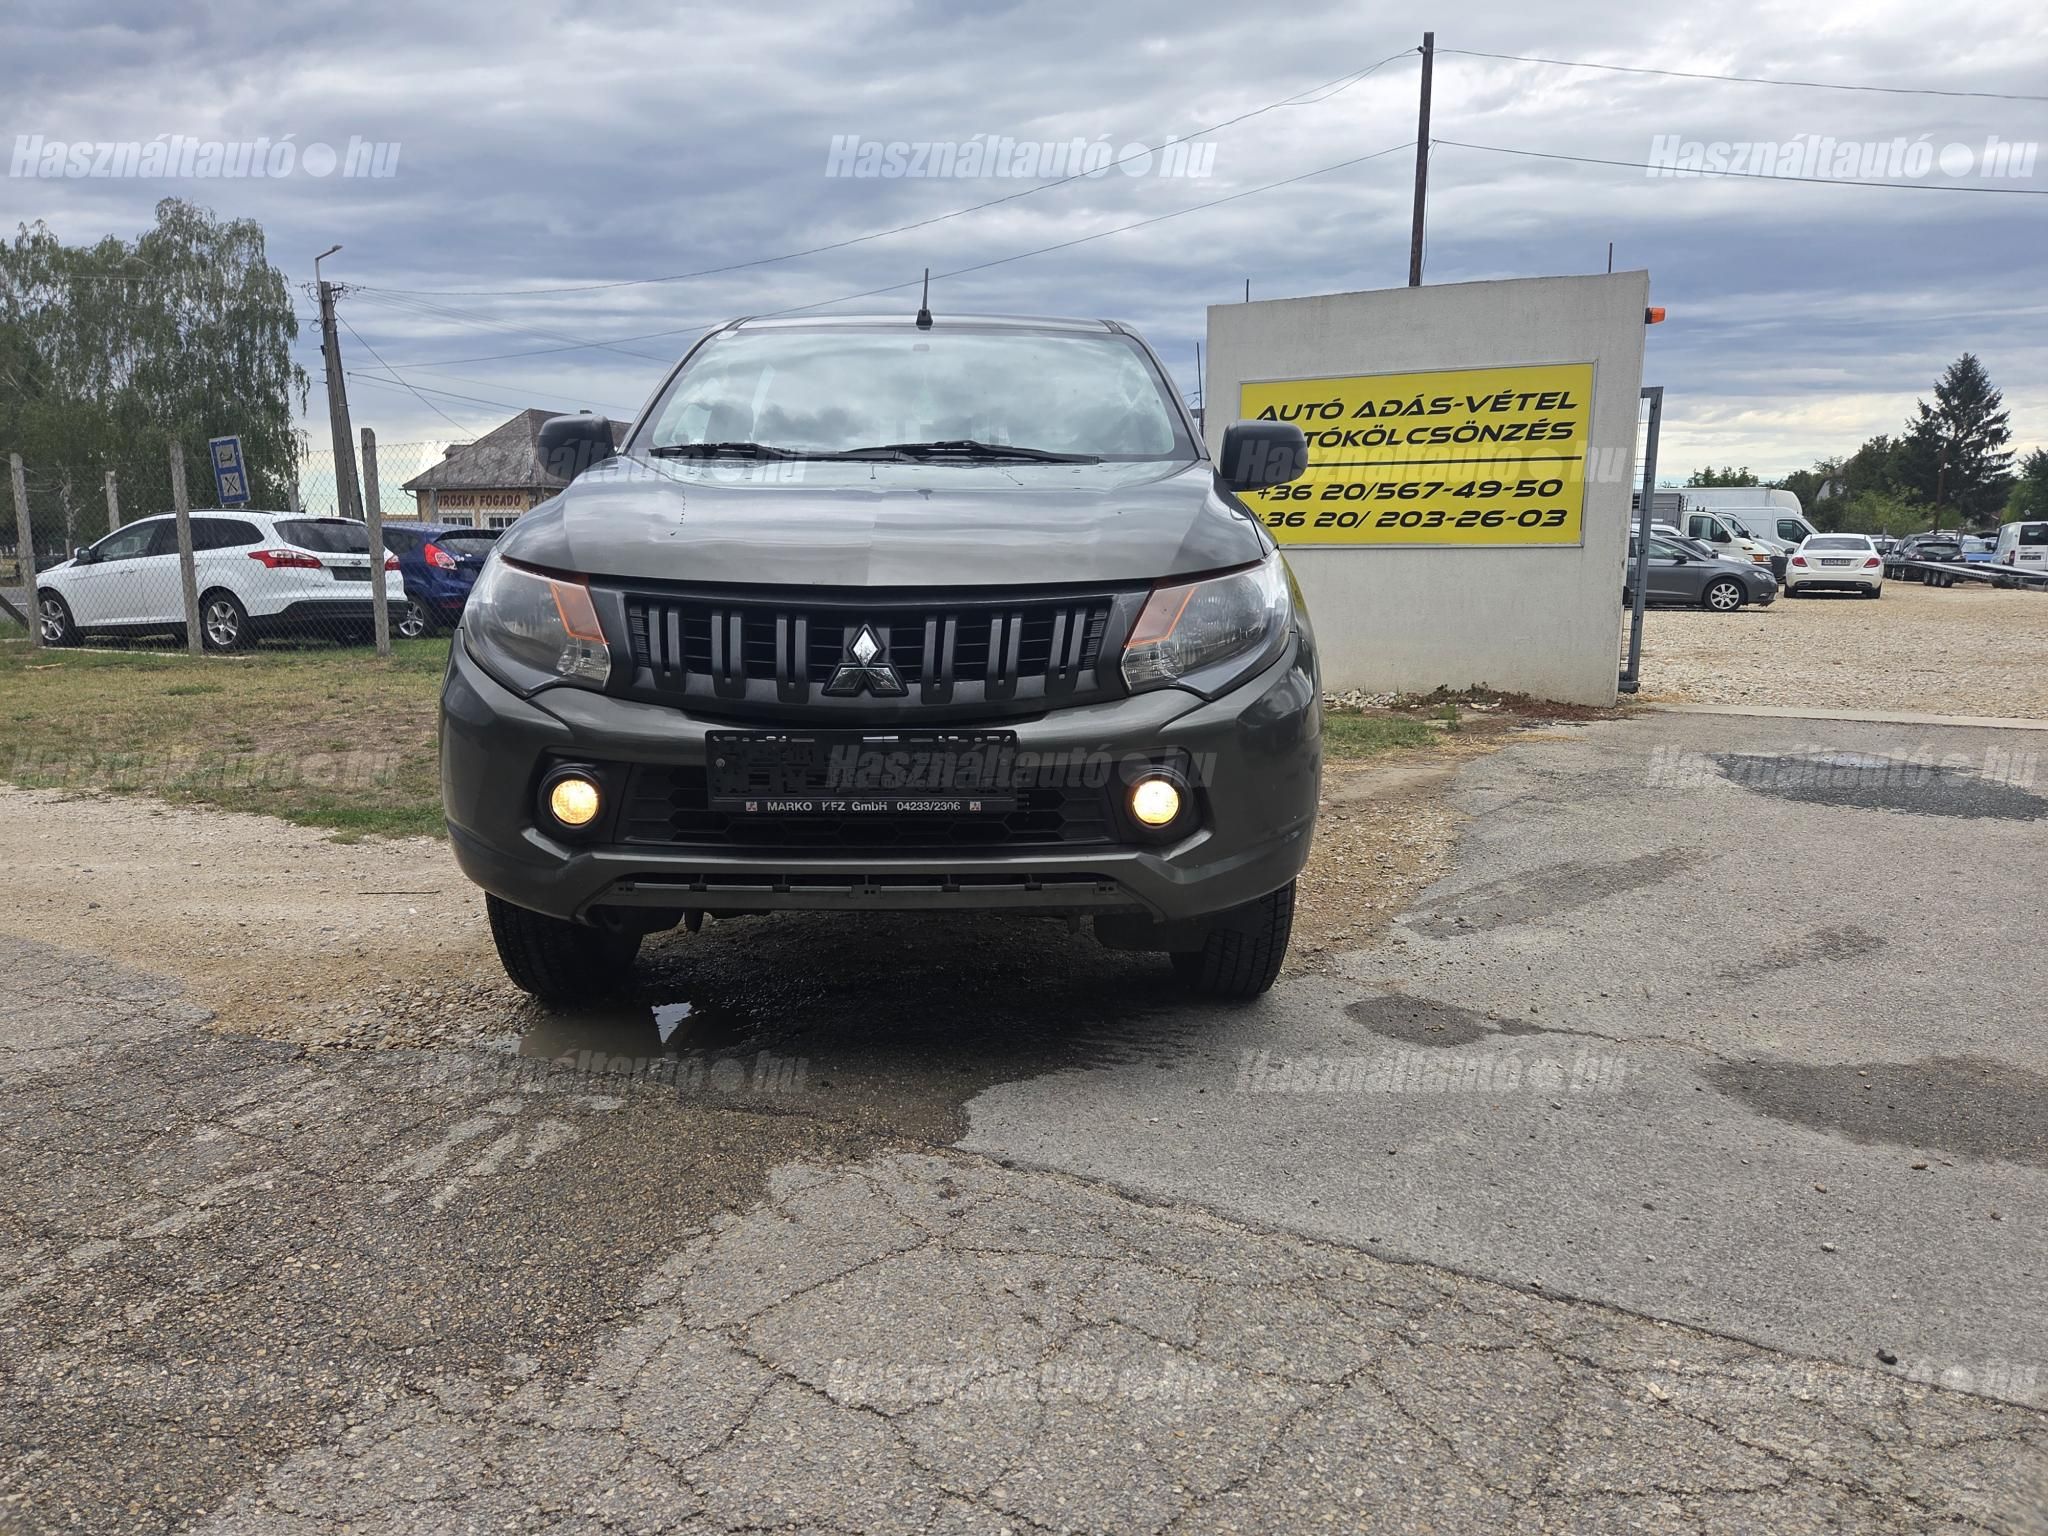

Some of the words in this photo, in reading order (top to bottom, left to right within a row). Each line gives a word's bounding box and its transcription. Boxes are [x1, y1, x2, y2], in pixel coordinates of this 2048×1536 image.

[1256, 398, 1345, 421] AUTÓ
[1351, 389, 1578, 418] ADÁS-VÉTEL
[1303, 418, 1577, 448] TÓKÖLCSÖNZÉS
[1257, 484, 1314, 501] +36
[1320, 479, 1564, 501] 20/567-49-50
[1375, 509, 1568, 528] 203-26-03
[767, 801, 813, 811] MARKO
[851, 801, 888, 811] GmbH
[896, 801, 961, 812] 04233/2306
